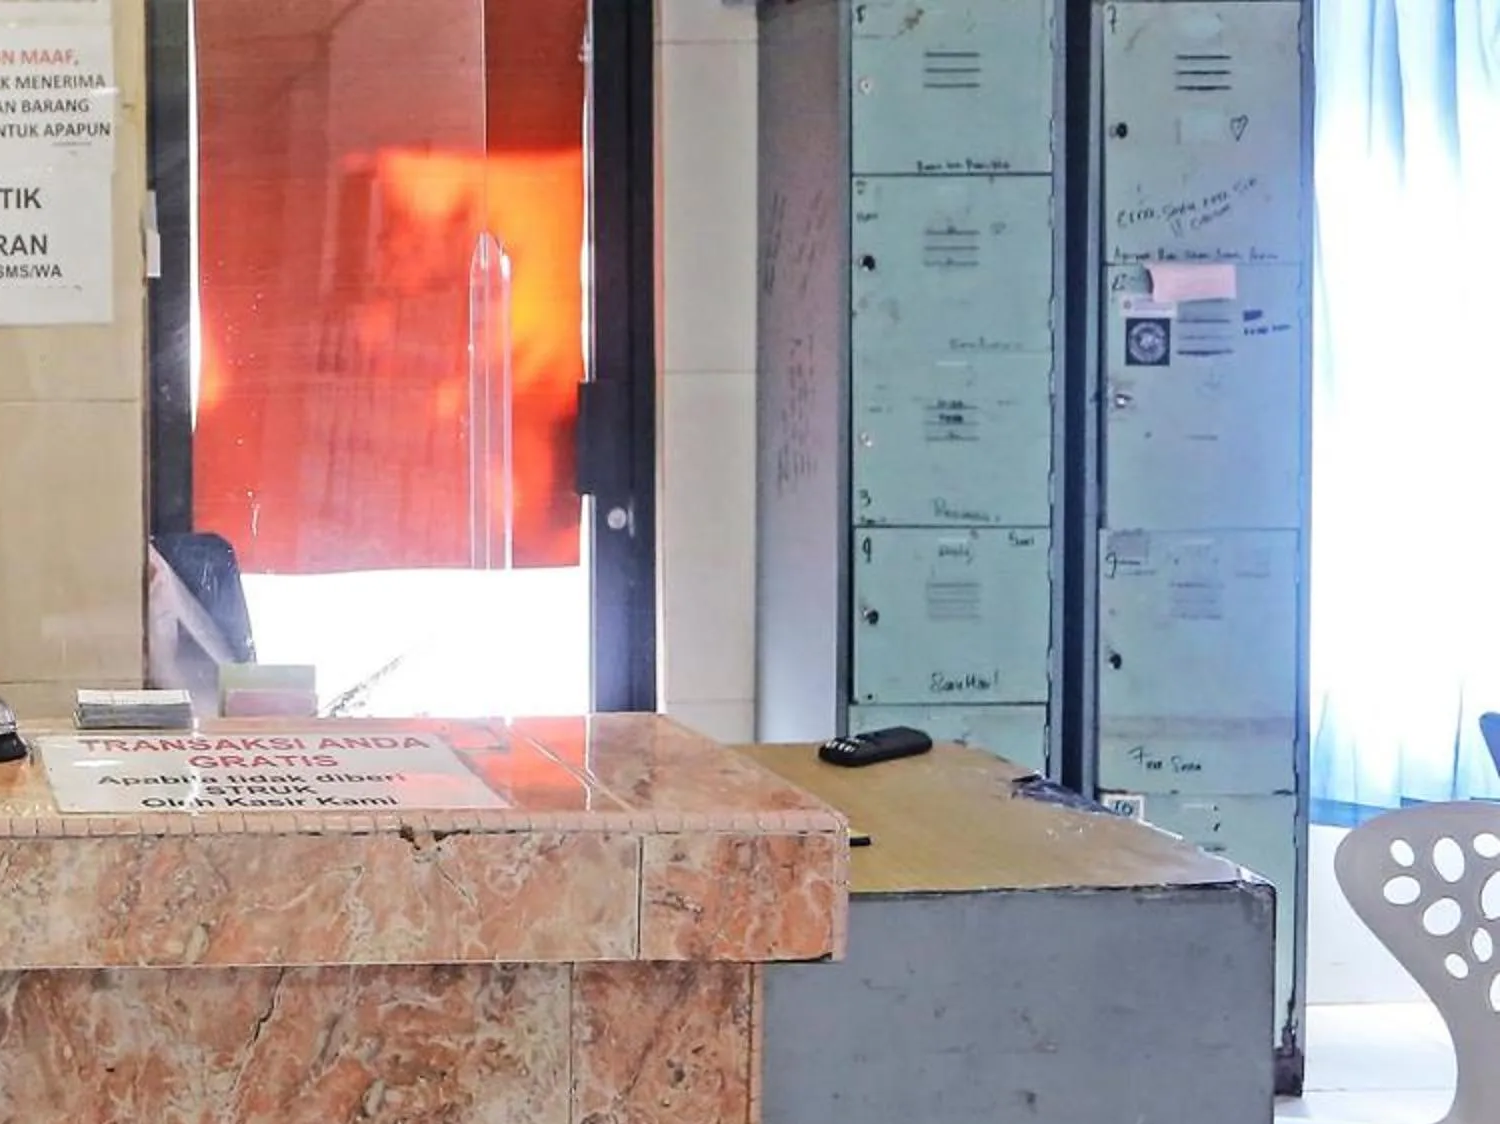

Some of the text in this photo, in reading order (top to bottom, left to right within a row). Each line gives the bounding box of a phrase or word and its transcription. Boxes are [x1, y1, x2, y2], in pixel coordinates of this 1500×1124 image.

[15, 74, 106, 89] MENERIMA
[21, 98, 90, 114] BARANG
[44, 122, 111, 137] APAPUN
[79, 737, 431, 752] TRANSAKSI ANDA
[188, 756, 339, 768] GRATIS
[226, 774, 306, 784] tidak
[316, 773, 407, 784] diberi
[206, 786, 319, 796] STRUK
[224, 796, 306, 807] Kasir
[315, 795, 399, 806] Kami
